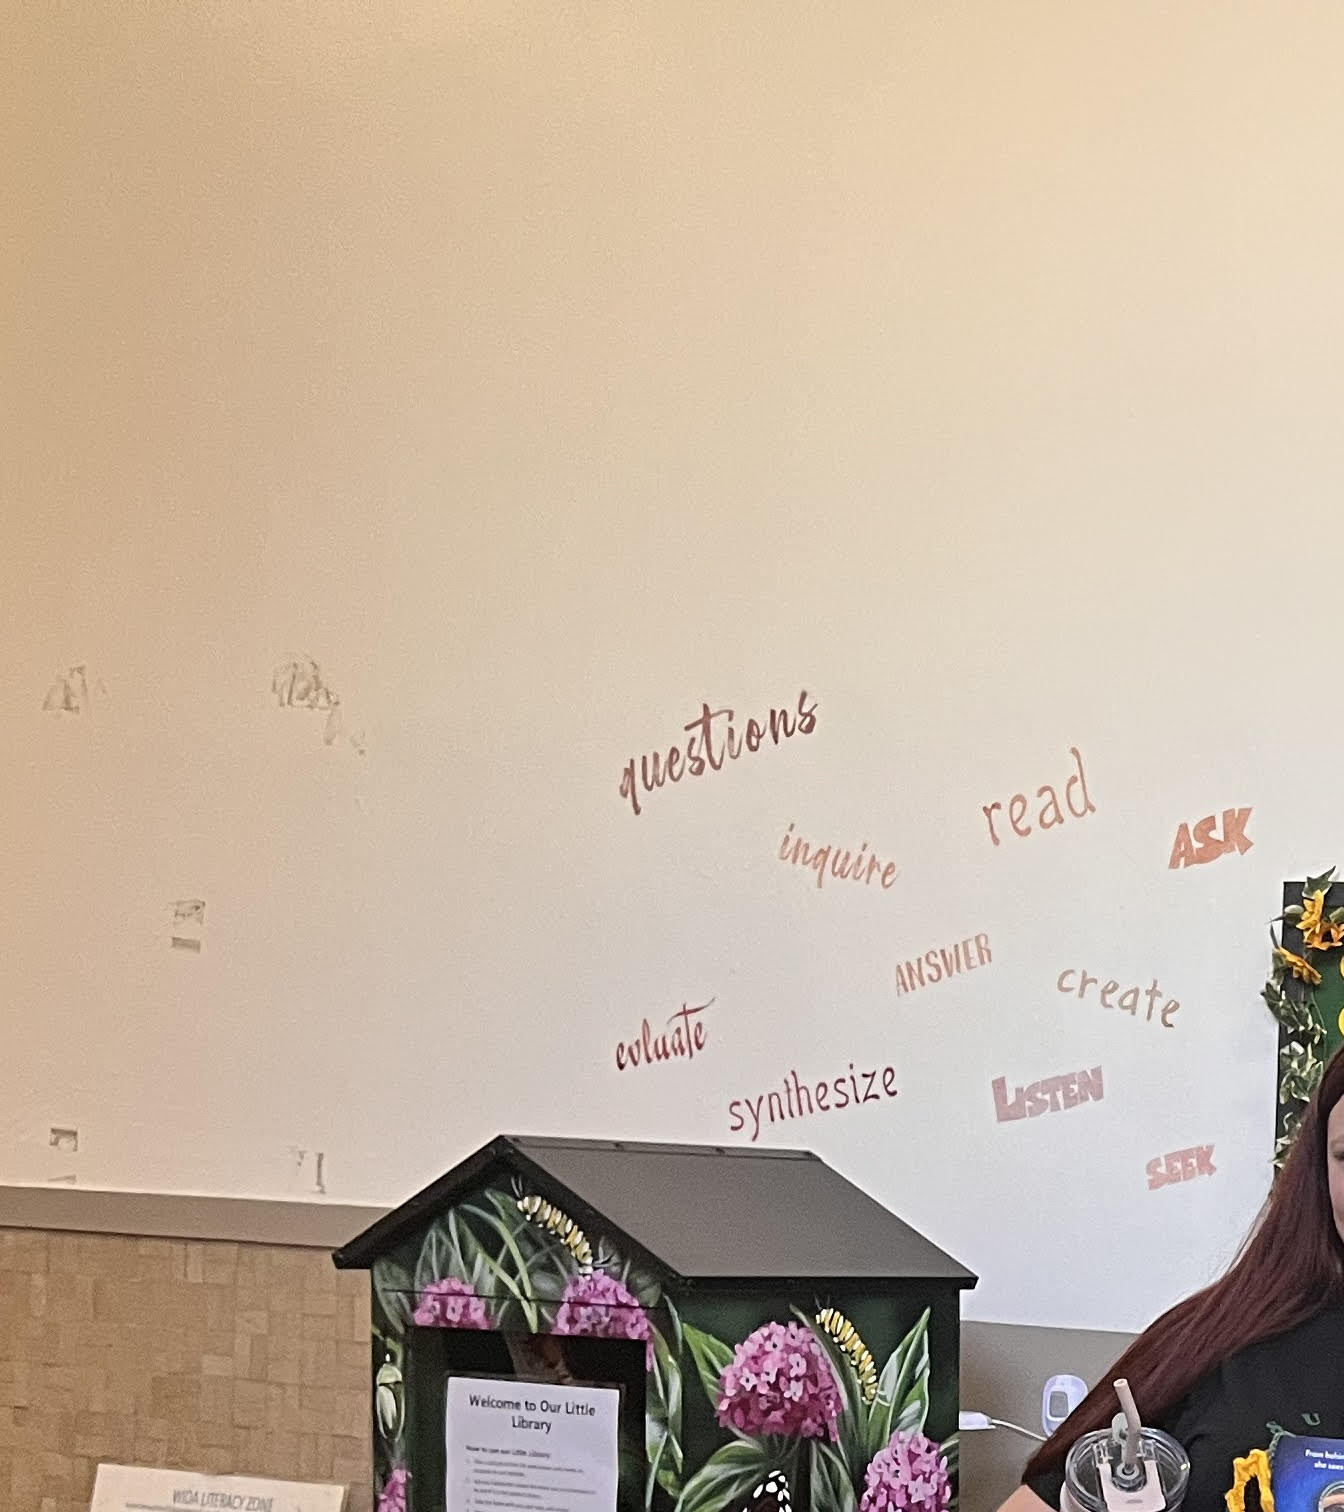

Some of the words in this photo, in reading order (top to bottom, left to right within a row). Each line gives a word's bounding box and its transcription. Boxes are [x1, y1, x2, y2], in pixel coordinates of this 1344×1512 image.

[619, 690, 818, 815] questions
[982, 747, 1097, 846] read
[777, 823, 900, 890] inquire
[1168, 808, 1254, 870] ASK
[895, 932, 993, 995] ANSWER
[1057, 968, 1181, 1028] create
[728, 1063, 898, 1141] synthesize
[1145, 1144, 1218, 1191] SEEK
[469, 1394, 521, 1411] Welcome
[525, 1399, 536, 1412] to
[540, 1400, 561, 1414] Our
[565, 1401, 596, 1417] Little
[511, 1415, 552, 1435] Library
